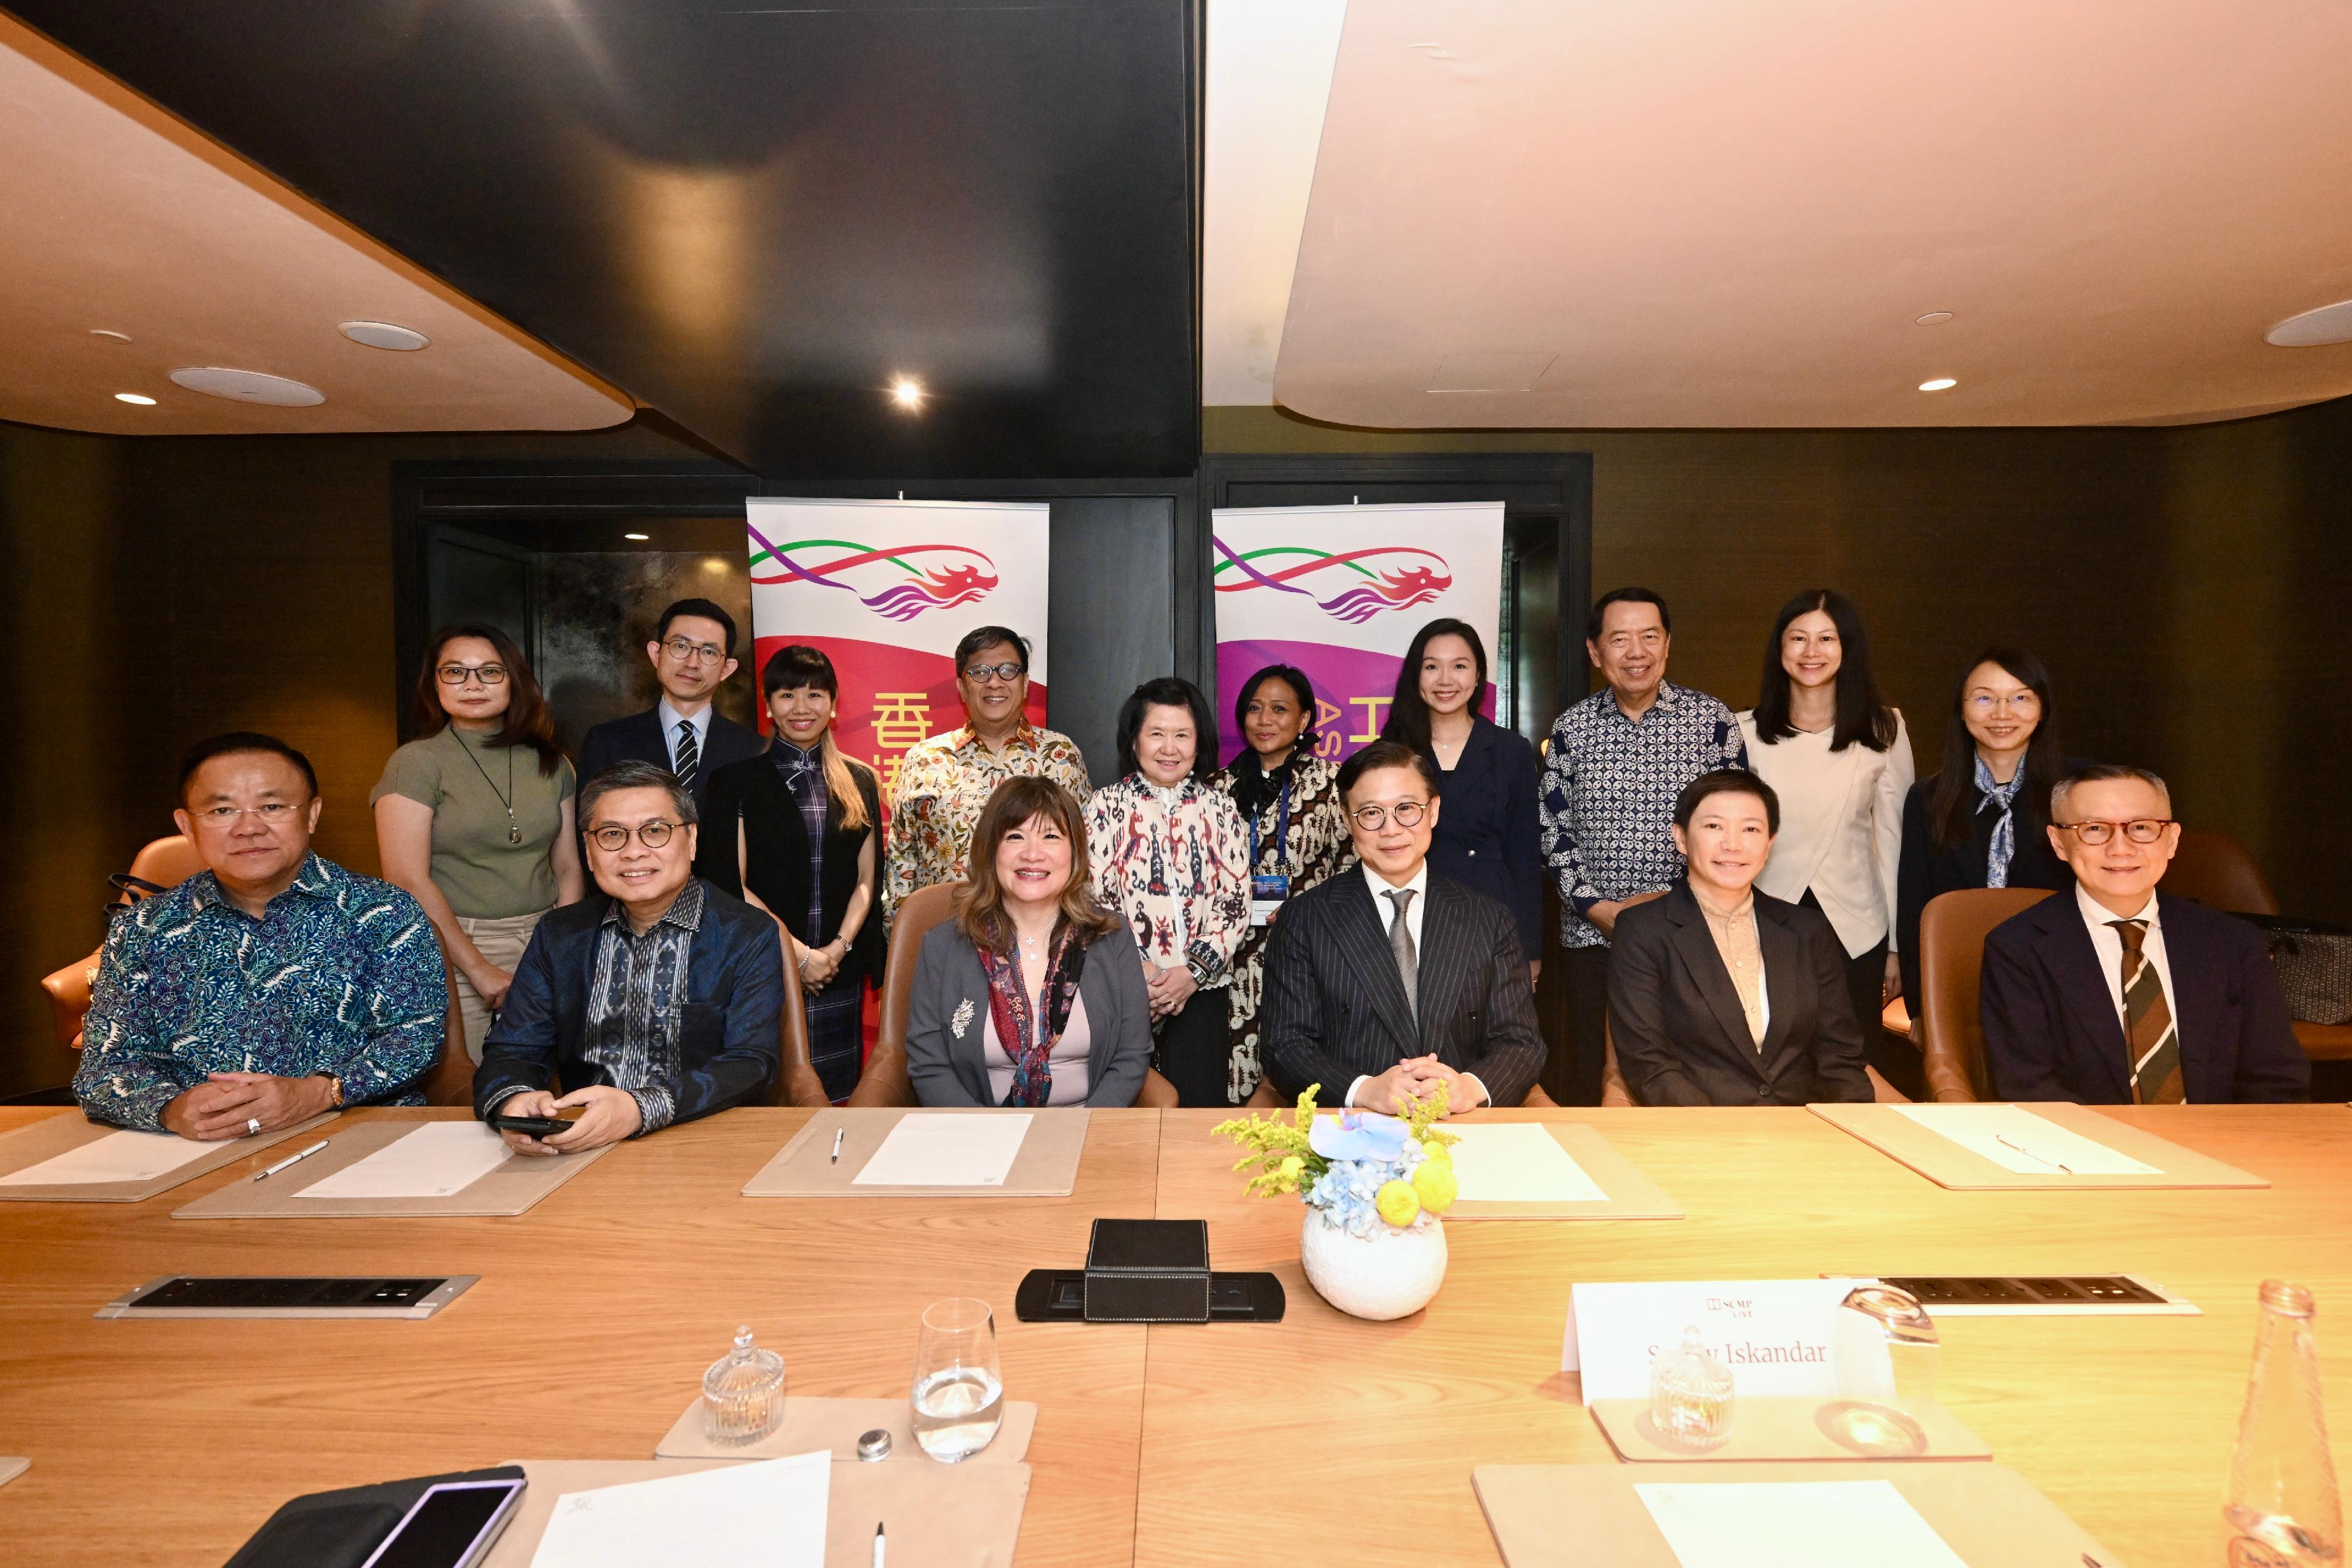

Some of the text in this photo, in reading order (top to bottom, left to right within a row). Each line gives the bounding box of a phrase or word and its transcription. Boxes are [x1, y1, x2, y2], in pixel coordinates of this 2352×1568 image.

[1314, 698, 1342, 765] AS
[1723, 1299, 1752, 1309] SCMP
[1725, 1340, 1827, 1365] Iskandar
